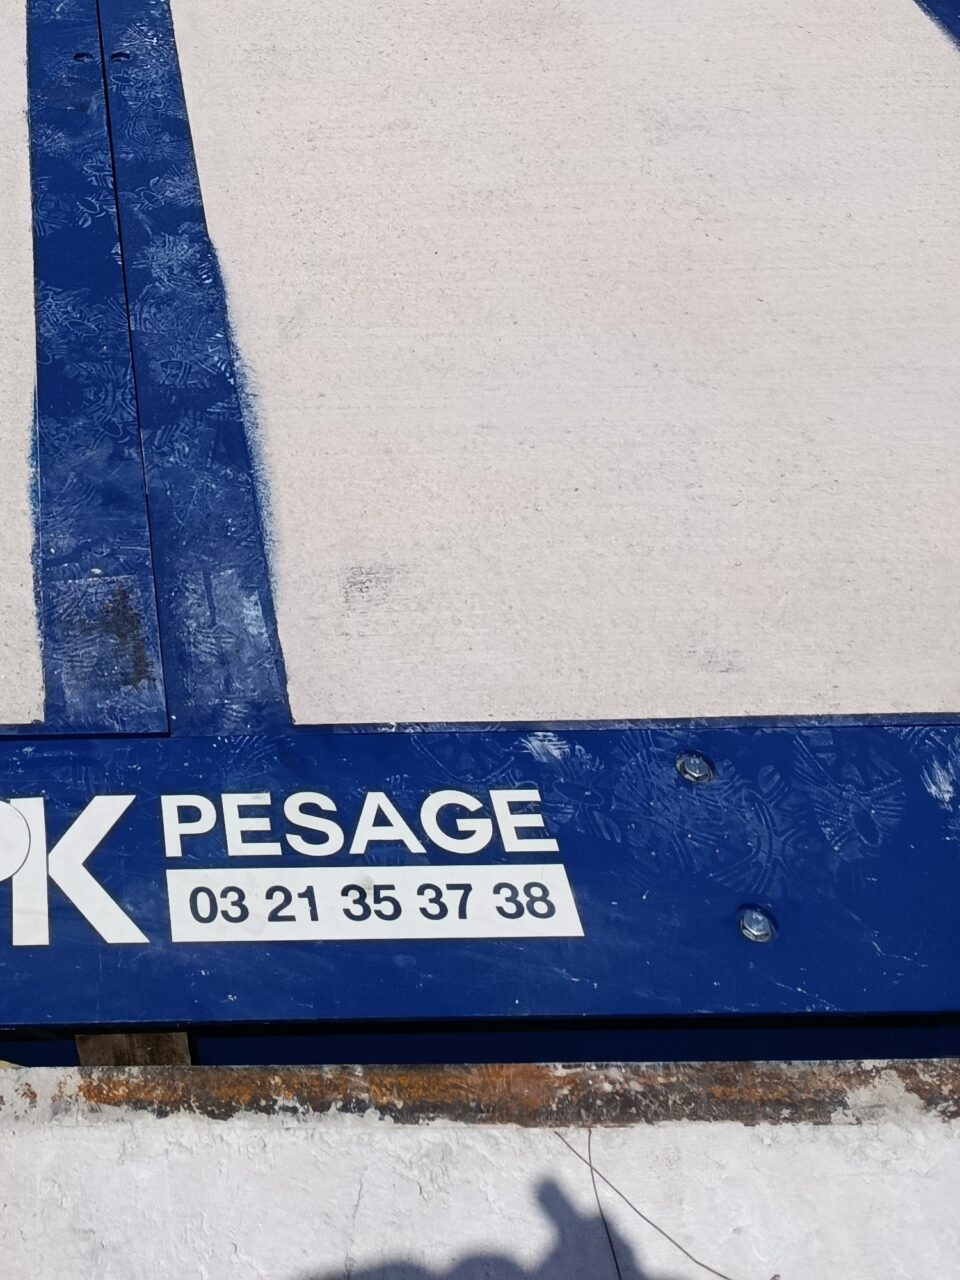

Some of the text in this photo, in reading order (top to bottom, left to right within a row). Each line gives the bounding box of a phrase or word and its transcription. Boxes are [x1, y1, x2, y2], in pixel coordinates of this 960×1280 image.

[160, 789, 560, 858] PESAGE
[189, 881, 556, 924] 03 21 35 37 38
